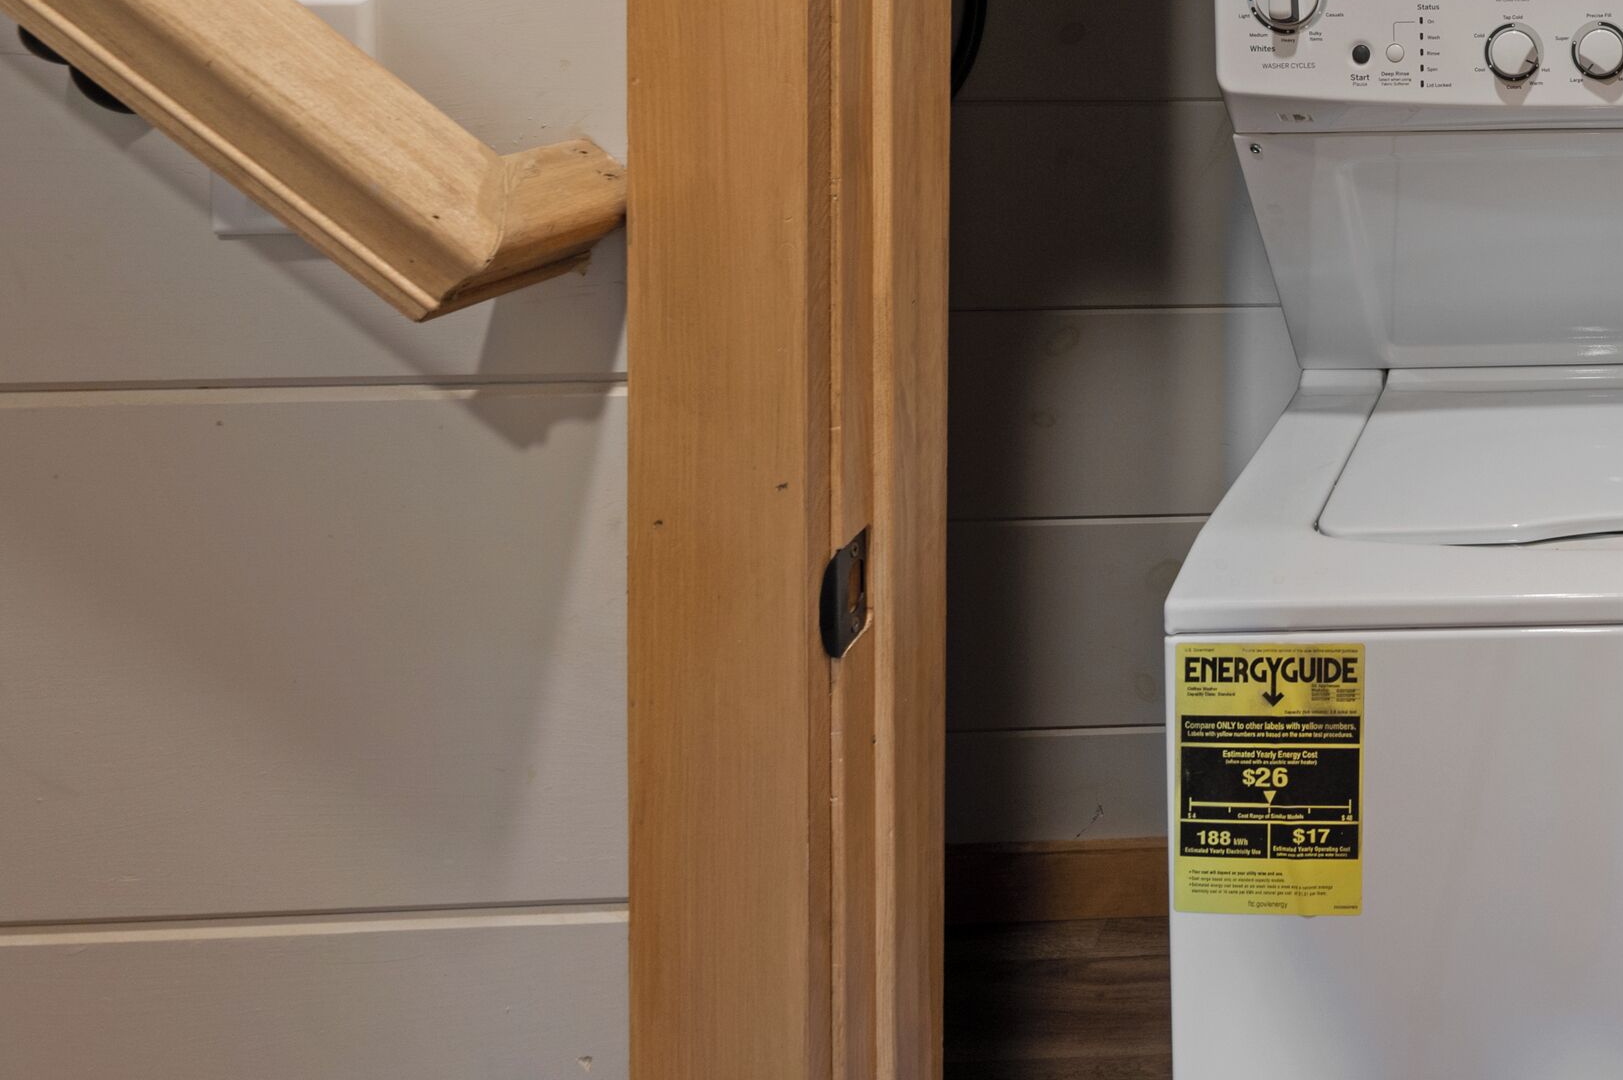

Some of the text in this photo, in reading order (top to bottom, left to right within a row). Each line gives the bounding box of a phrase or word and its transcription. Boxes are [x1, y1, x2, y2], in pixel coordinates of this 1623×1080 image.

[1184, 656, 1358, 684] ENERGYGUIDE
[1184, 721, 1356, 732] Compare ONLY to other labels with yellow numbers.
[1222, 750, 1318, 760] Estimated Yearly Energy Cost
[1242, 766, 1288, 788] $26
[1196, 830, 1249, 846] 188 kWh
[1292, 828, 1331, 845] $17
